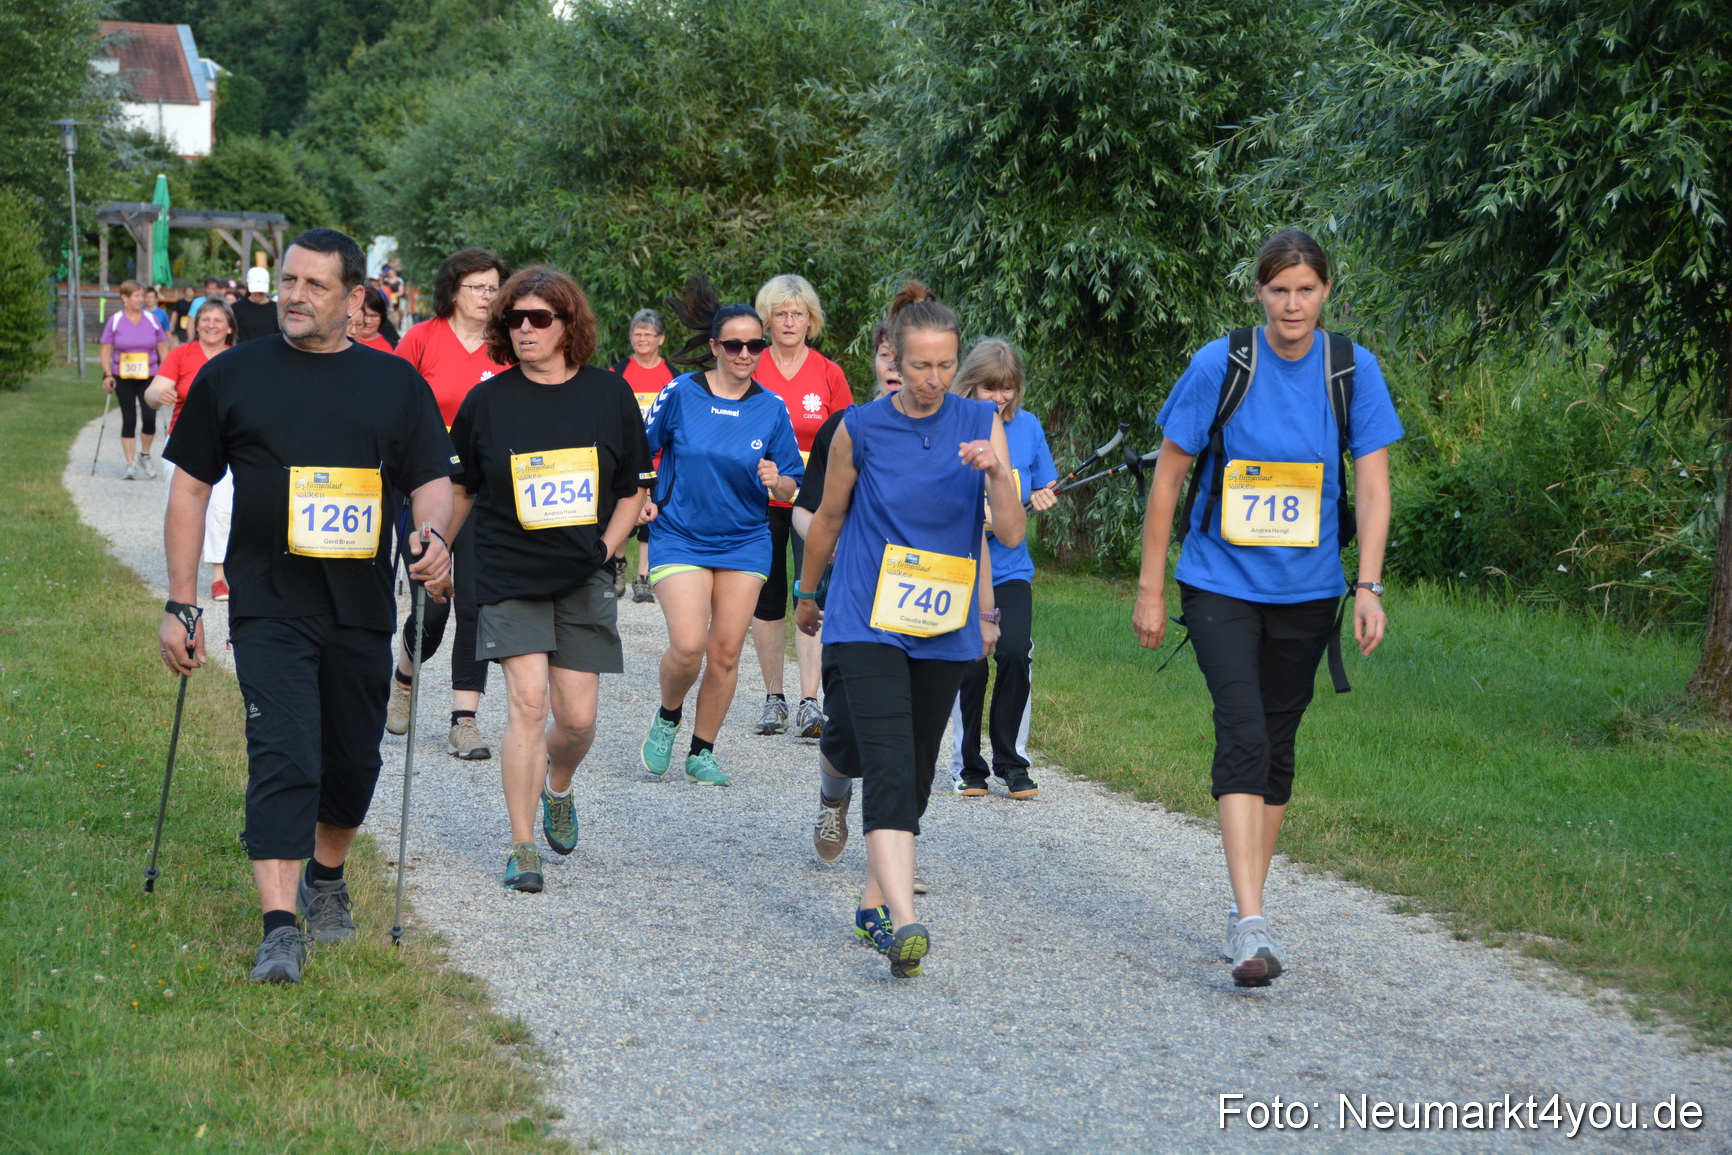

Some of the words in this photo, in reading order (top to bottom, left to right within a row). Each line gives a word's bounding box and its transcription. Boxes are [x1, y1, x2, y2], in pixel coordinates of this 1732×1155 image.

[124, 363, 142, 372] 307
[711, 406, 740, 417] hummel
[306, 482, 343, 490] firmenlauf
[296, 491, 325, 499] walken
[524, 478, 594, 508] 1254
[1242, 495, 1300, 523] 718
[301, 503, 372, 533] 1261
[896, 560, 931, 573] firmenlauf
[897, 582, 952, 616] 740
[900, 615, 922, 625] Claudia
[922, 619, 939, 627] Müller
